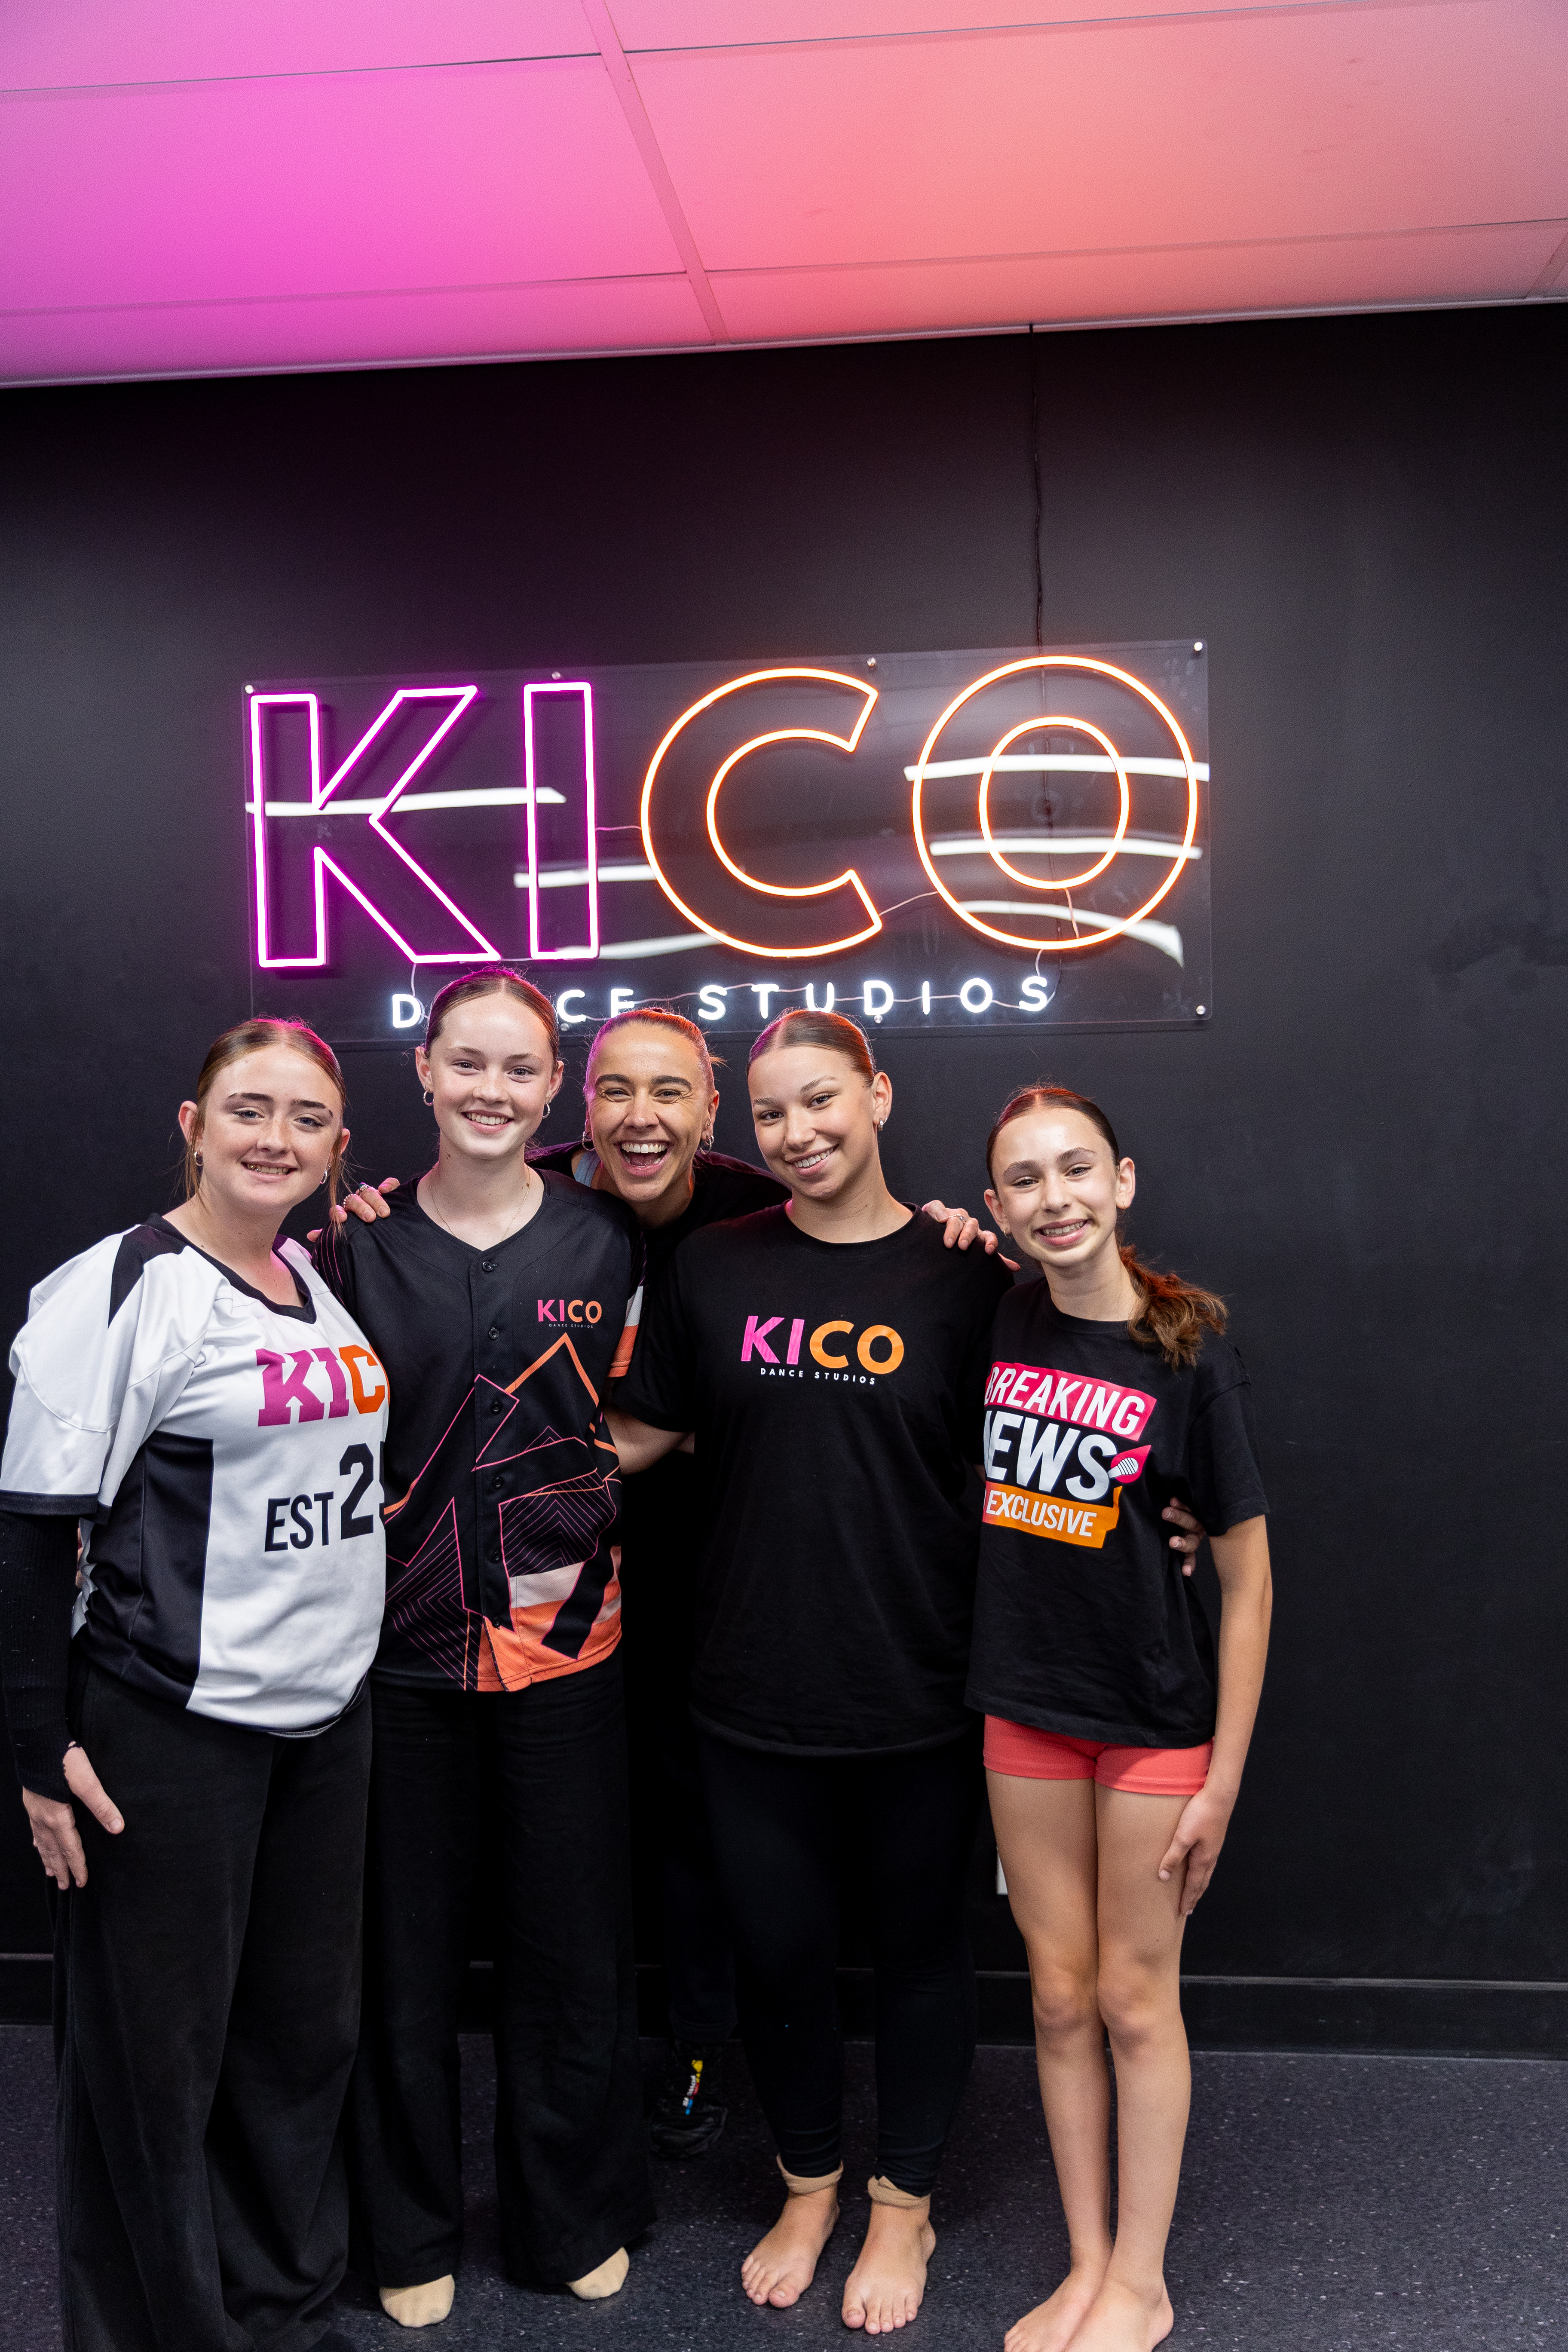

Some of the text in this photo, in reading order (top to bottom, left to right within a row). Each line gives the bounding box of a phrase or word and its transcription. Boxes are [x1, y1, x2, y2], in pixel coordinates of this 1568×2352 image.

[250, 655, 1198, 968] KICO
[392, 976, 1047, 1028] DCE STUDIOS
[538, 1299, 602, 1323] KICO
[741, 1316, 904, 1374] KICO
[256, 1344, 390, 1427] KIC
[761, 1368, 876, 1385] DANCE STUDIOS
[985, 1366, 1145, 1435] BREAKING
[986, 1490, 1097, 1537] EXCLUSIVE
